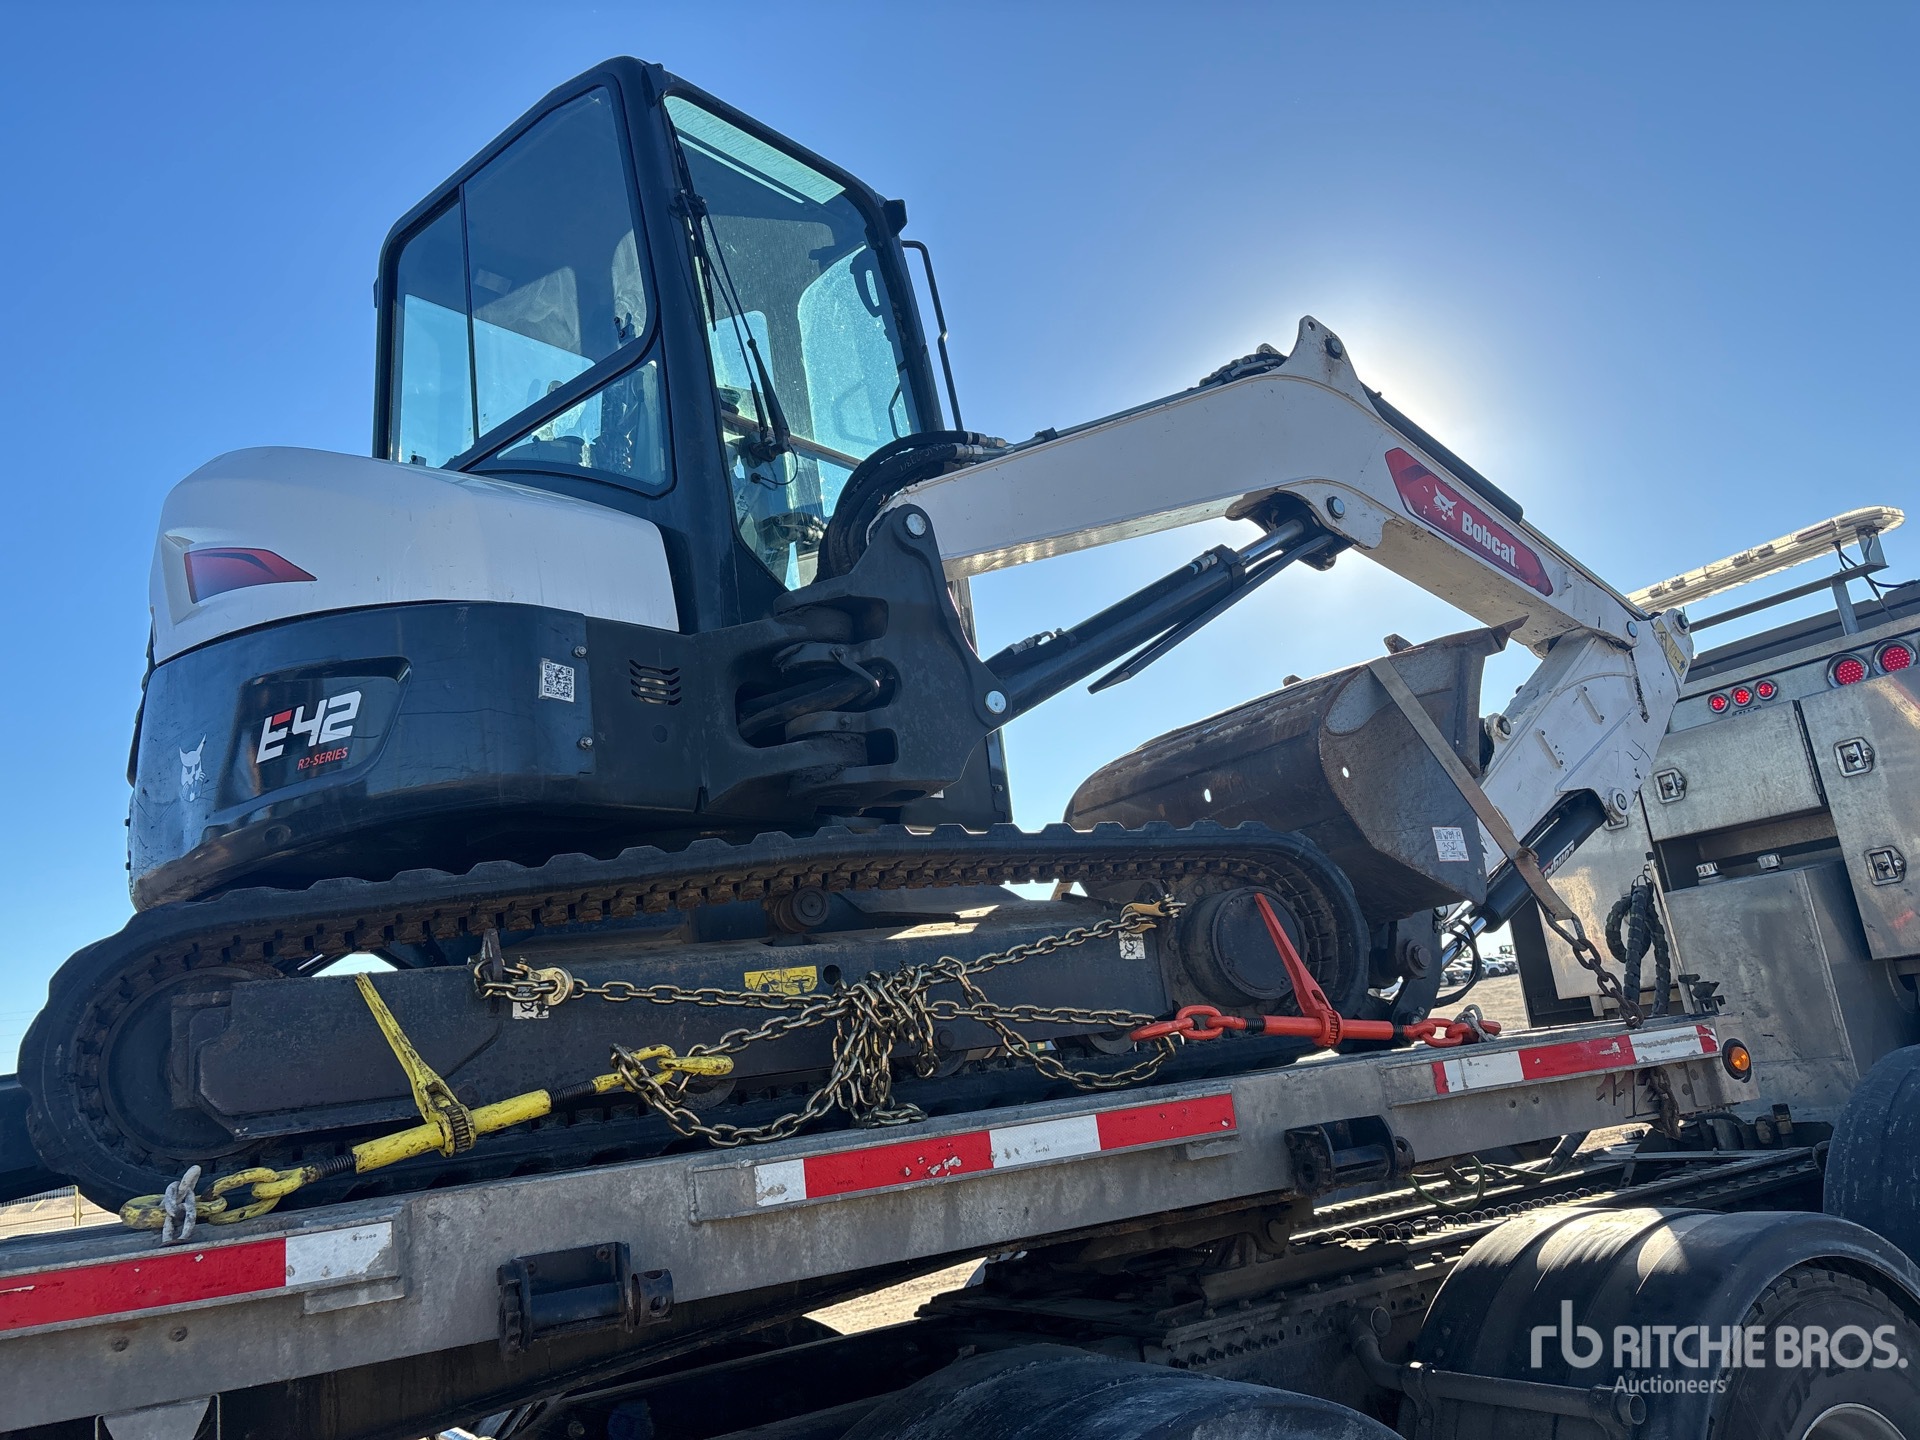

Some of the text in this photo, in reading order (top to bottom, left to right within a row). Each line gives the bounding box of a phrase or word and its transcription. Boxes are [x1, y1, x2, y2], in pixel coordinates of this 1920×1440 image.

[1461, 511, 1516, 568] Bobcat
[256, 691, 362, 764] E42
[297, 747, 349, 771] R2-SERIES
